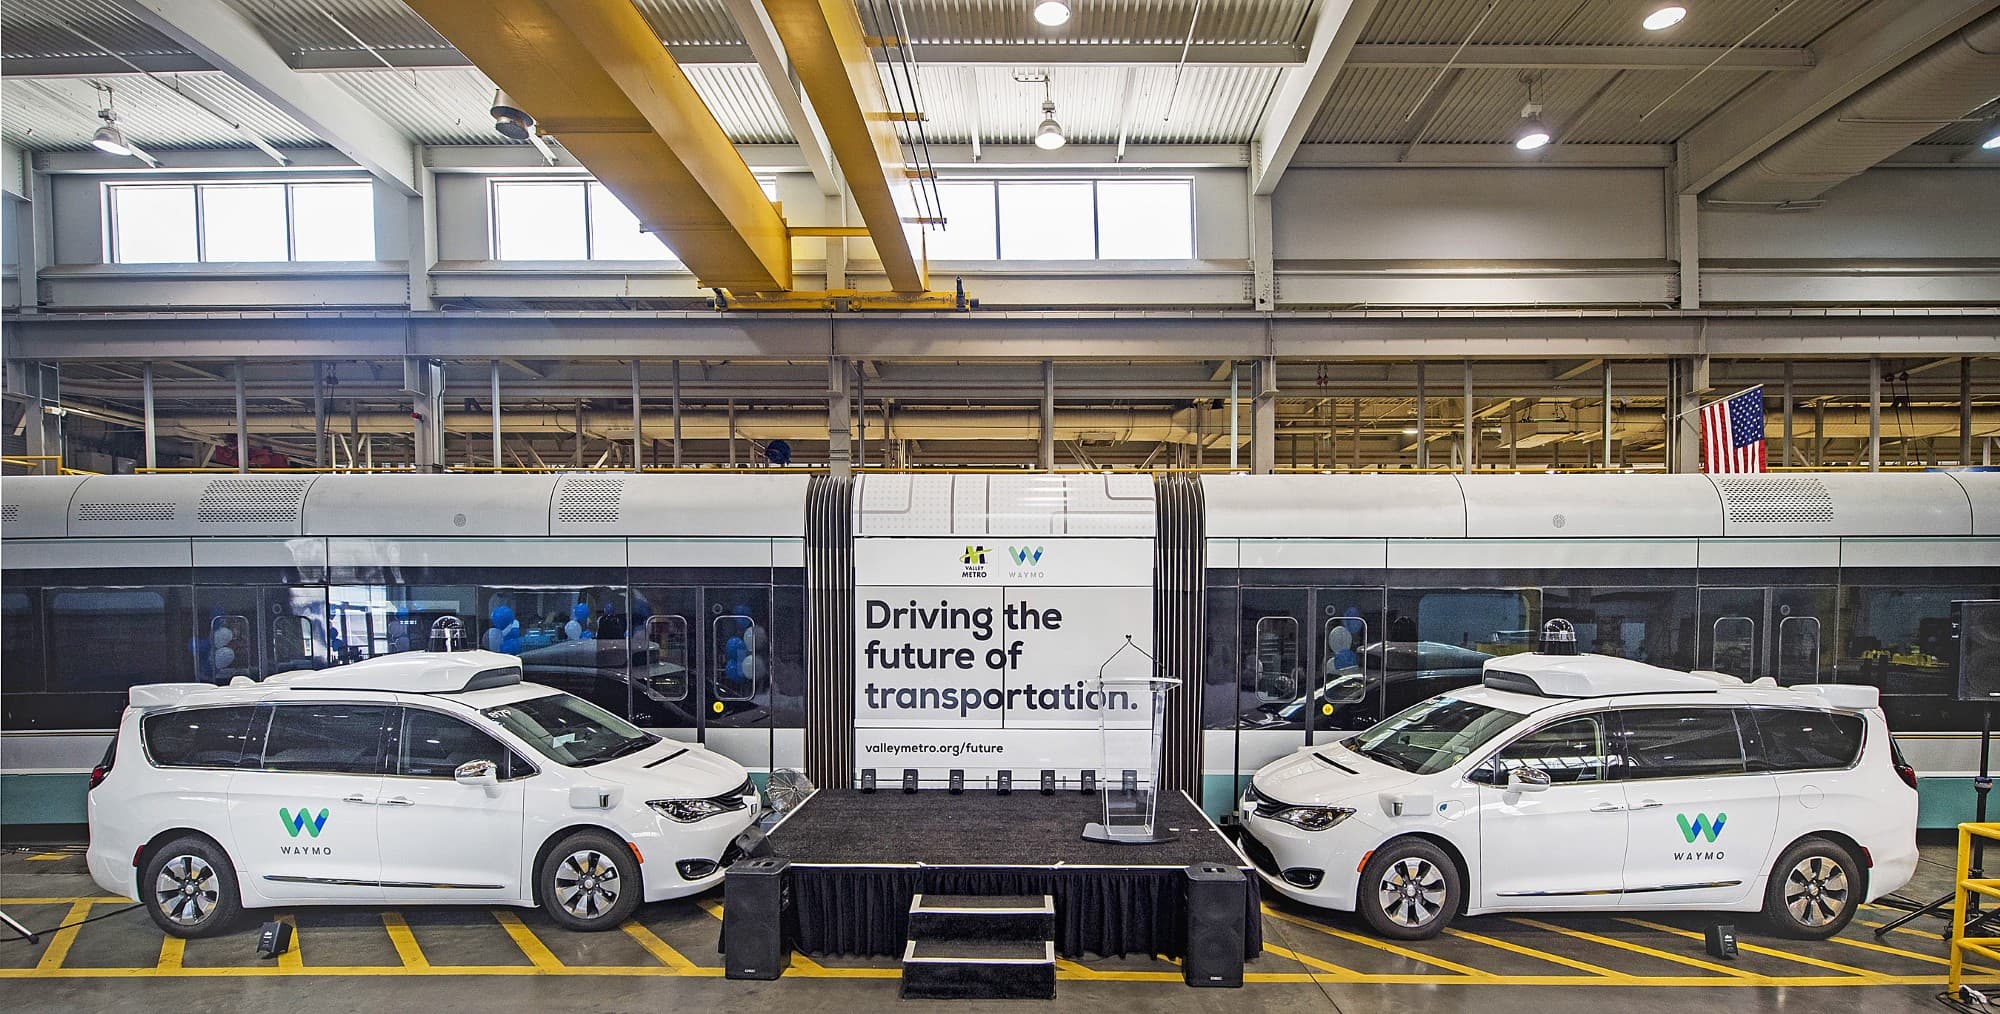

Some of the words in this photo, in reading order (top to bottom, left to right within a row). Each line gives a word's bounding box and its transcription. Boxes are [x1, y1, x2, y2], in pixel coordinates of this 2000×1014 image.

[1008, 571, 1044, 579] WAYMO
[866, 600, 993, 640] Driving
[1004, 601, 1063, 630] the
[865, 640, 975, 670] future
[985, 641, 1024, 670] of
[865, 681, 1138, 718] transportation.
[865, 742, 1004, 757] valleymetro.org/future
[280, 846, 332, 855] WAYMO
[1673, 851, 1725, 860] WAYMO
